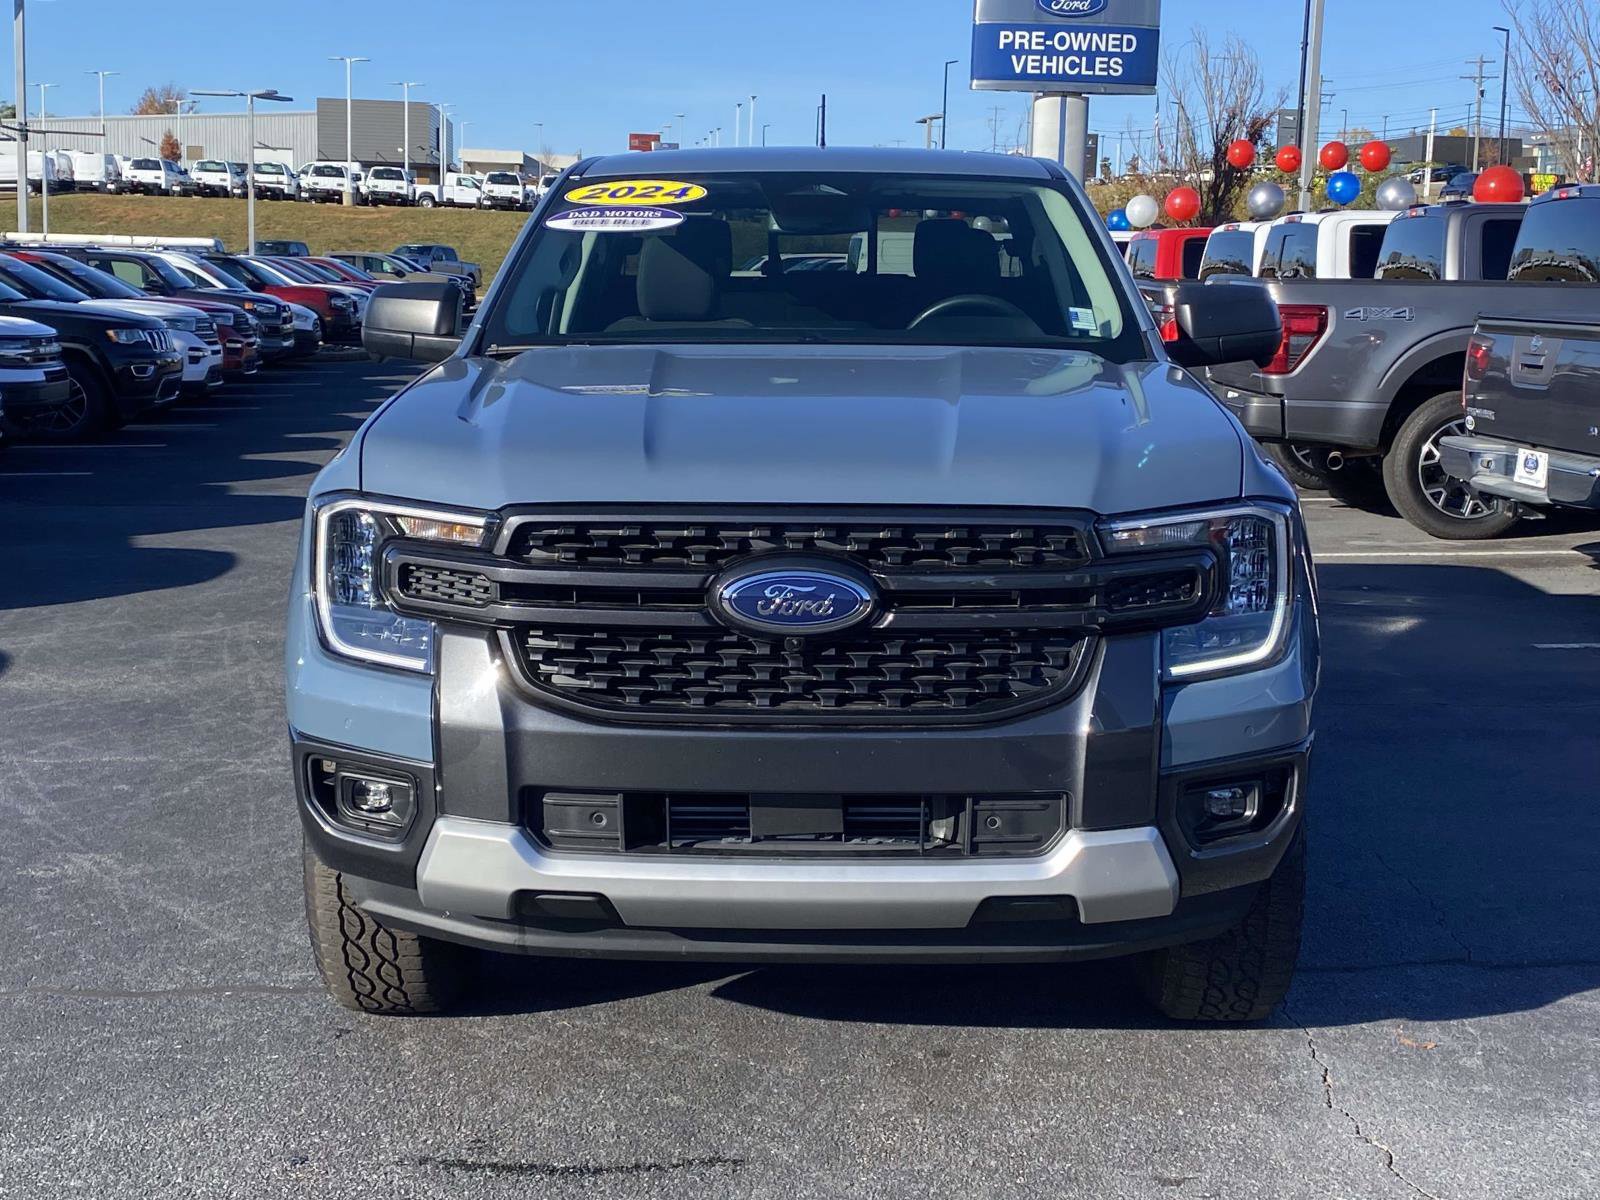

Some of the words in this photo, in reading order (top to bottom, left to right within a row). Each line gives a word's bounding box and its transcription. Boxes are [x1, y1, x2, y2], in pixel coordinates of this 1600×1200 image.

[999, 30, 1137, 53] PRE-OWNED
[1011, 54, 1123, 76] VEHICLES
[577, 186, 693, 200] 2024
[603, 210, 662, 218] MOTORS
[757, 584, 835, 616] Ford
